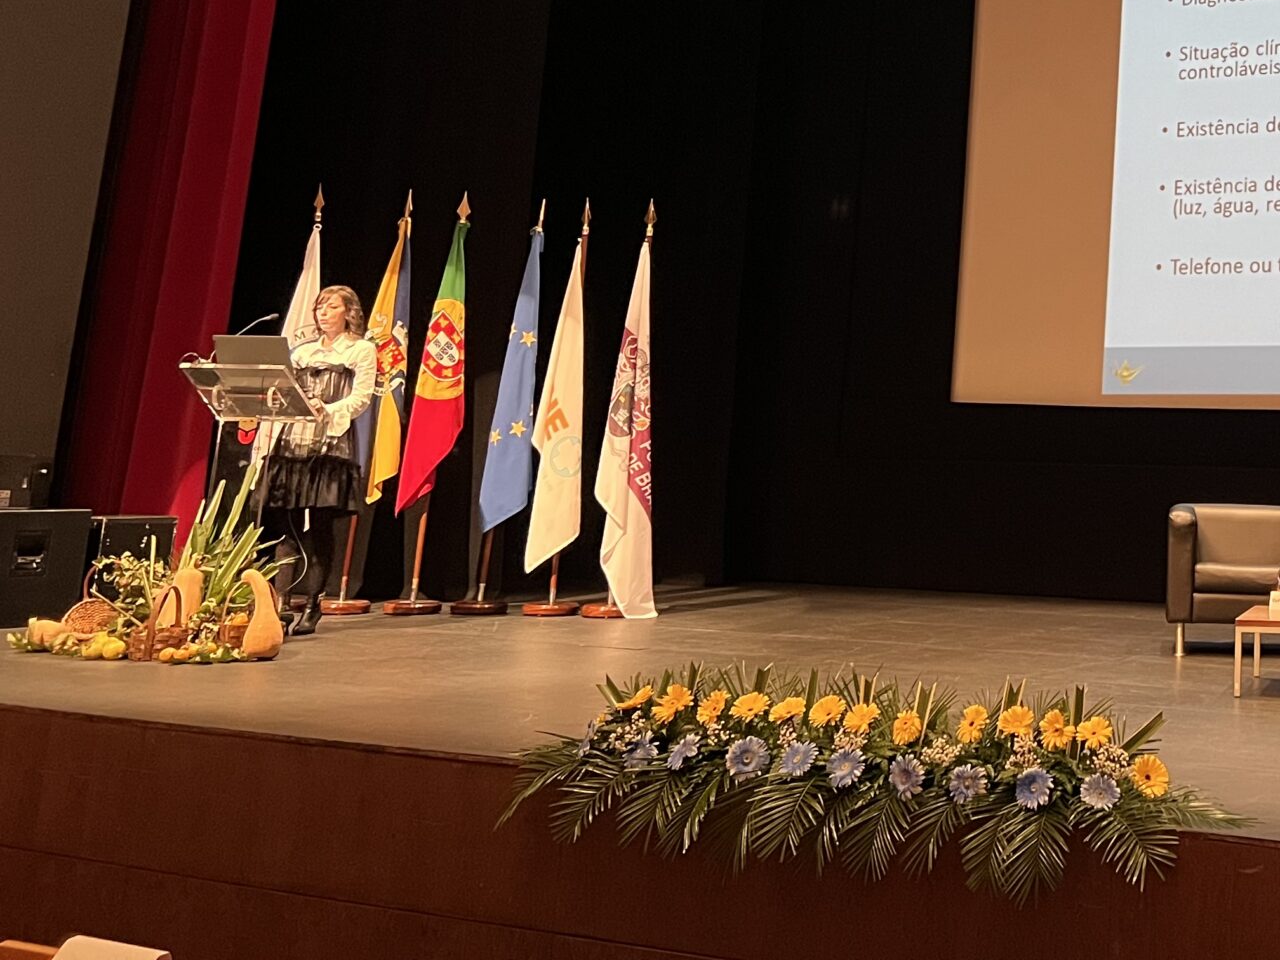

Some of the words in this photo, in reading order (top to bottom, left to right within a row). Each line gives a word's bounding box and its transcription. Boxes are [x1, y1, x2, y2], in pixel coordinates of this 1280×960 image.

[1178, 41, 1250, 64] Situação
[1176, 118, 1259, 138] Existência
[1174, 176, 1258, 196] Existência
[1173, 198, 1207, 220] (luz,
[1213, 196, 1259, 219] água,
[1170, 256, 1244, 276] Telefone
[1249, 260, 1272, 274] ou
